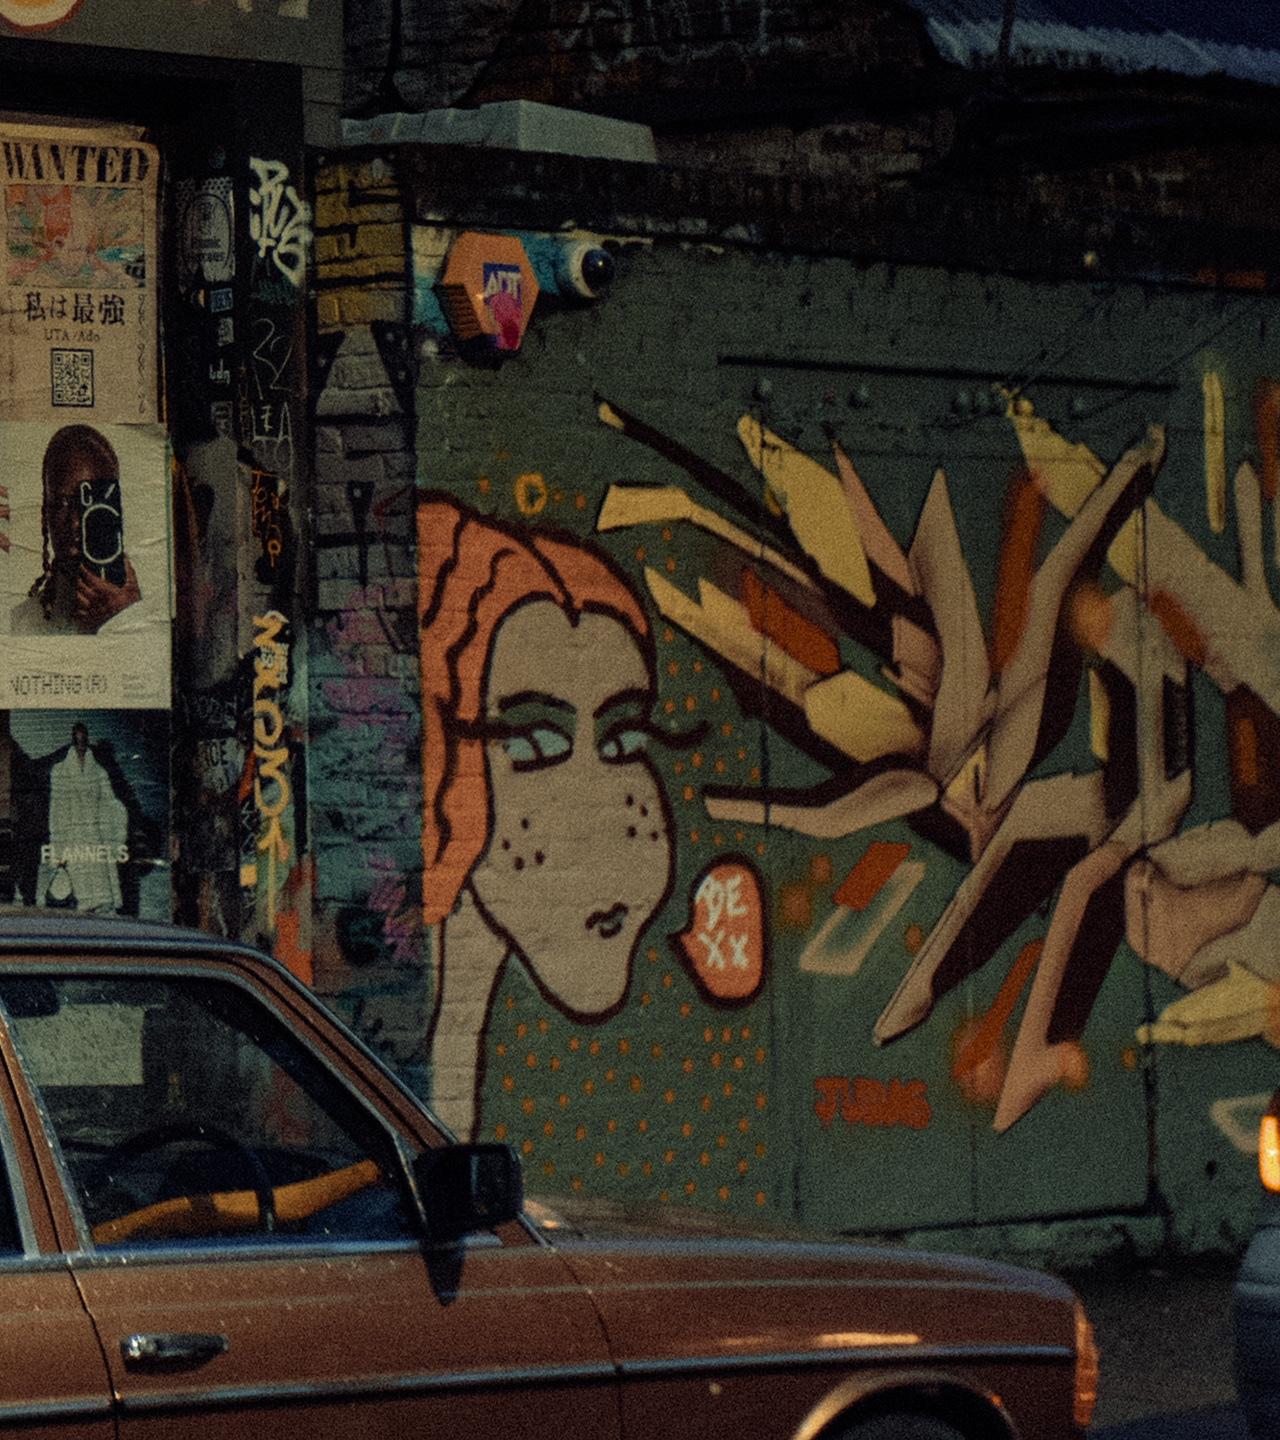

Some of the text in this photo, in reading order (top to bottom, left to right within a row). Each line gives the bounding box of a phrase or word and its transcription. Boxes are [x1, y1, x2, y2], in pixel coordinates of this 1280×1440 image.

[2, 140, 151, 184] WANTED
[24, 291, 128, 327] 私は最強
[41, 844, 131, 864] FLANNELS
